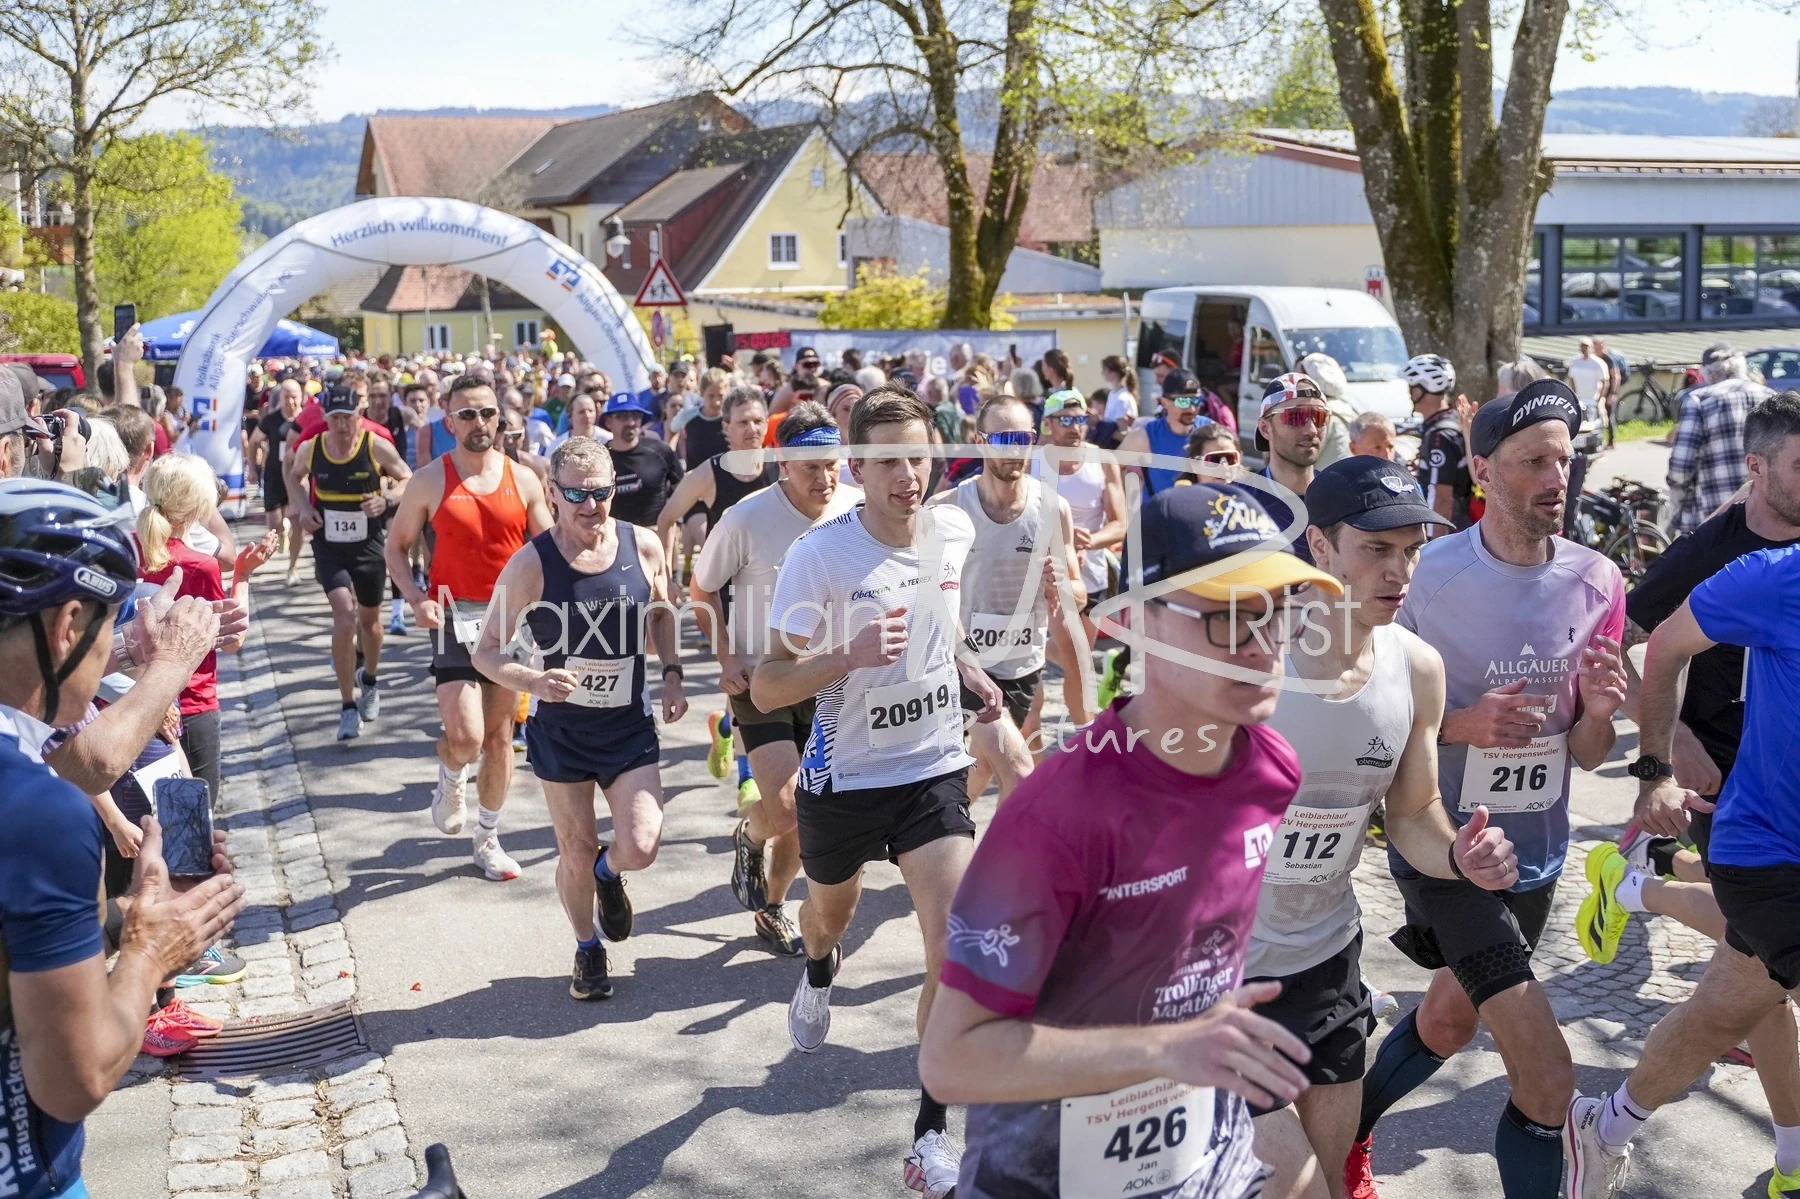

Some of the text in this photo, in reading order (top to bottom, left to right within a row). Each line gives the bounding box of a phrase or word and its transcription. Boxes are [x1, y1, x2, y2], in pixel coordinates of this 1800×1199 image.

[330, 217, 508, 248] Herzlich willkommen!
[1512, 394, 1577, 427] DYNAFIT
[334, 521, 357, 532] 134
[80, 570, 114, 594] ABUS
[1484, 659, 1569, 679] ALLGÄUER
[581, 674, 619, 692] 427
[1490, 676, 1564, 685] ALPEWASSER
[870, 684, 950, 730] 20919
[1502, 748, 1560, 760] Hergensweiler
[1489, 763, 1548, 793] 216
[1294, 810, 1348, 820] Leiblachlauf
[1524, 801, 1546, 811] AOK
[1280, 817, 1357, 830] SV Hergensweiler
[1283, 831, 1342, 860] 112
[1284, 861, 1322, 869] Sebastian
[1106, 866, 1188, 900] INTERSPORT
[1308, 873, 1329, 884] AOK
[1155, 966, 1234, 1004] Trollinger
[1151, 989, 1230, 1021] Maratho
[1086, 1084, 1198, 1125] TSV Hergensweil
[1110, 1081, 1179, 1108] Leiblachla
[1104, 1106, 1187, 1163] 426
[1138, 1160, 1157, 1172] Jan
[1122, 1176, 1154, 1192] AOK
